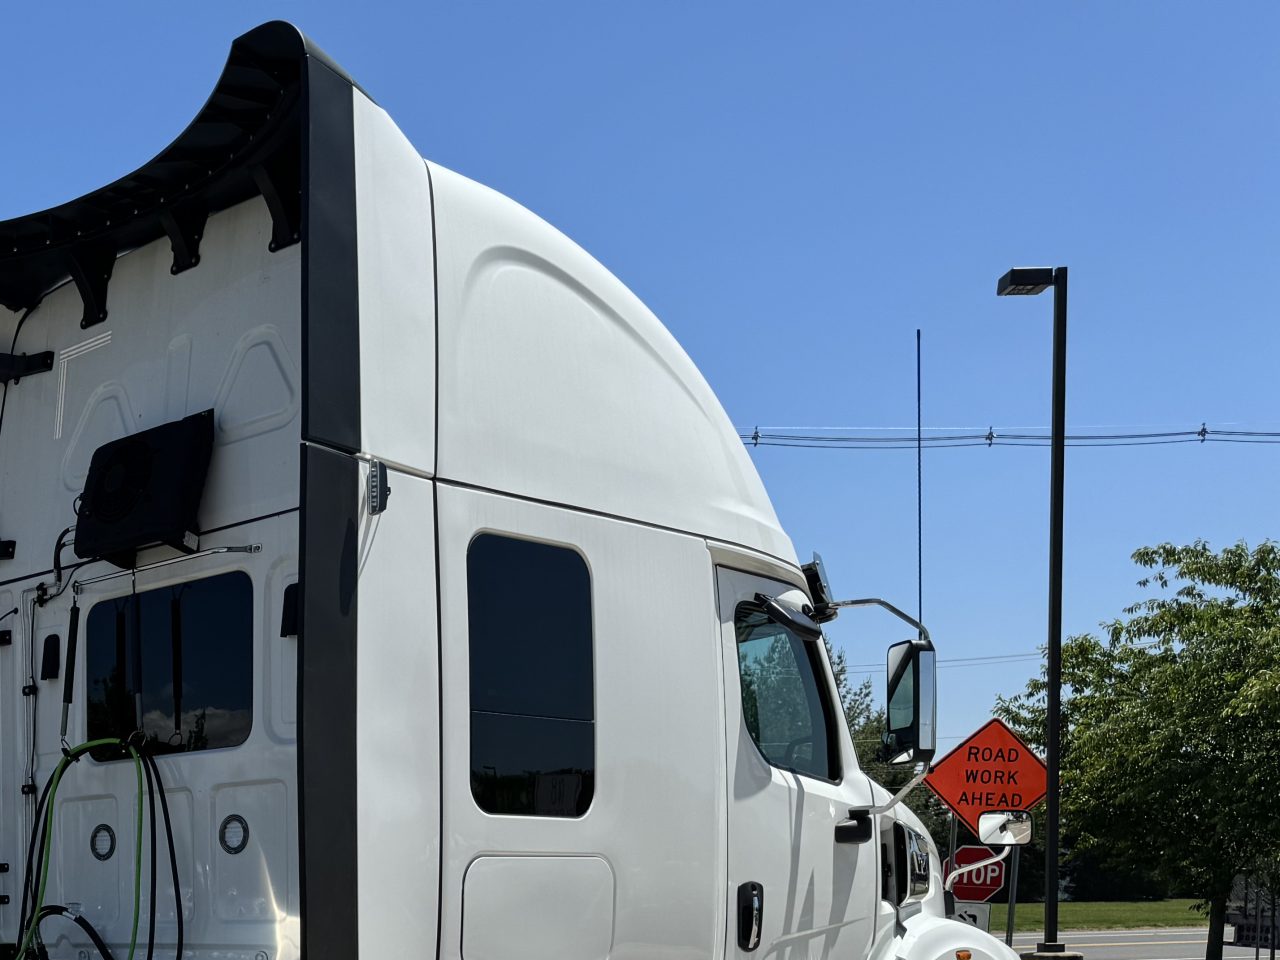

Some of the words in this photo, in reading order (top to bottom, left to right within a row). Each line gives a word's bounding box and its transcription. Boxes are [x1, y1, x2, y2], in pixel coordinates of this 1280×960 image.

[967, 746, 1019, 762] ROAD
[965, 769, 1018, 785] WORK
[957, 791, 1022, 808] AHEAD
